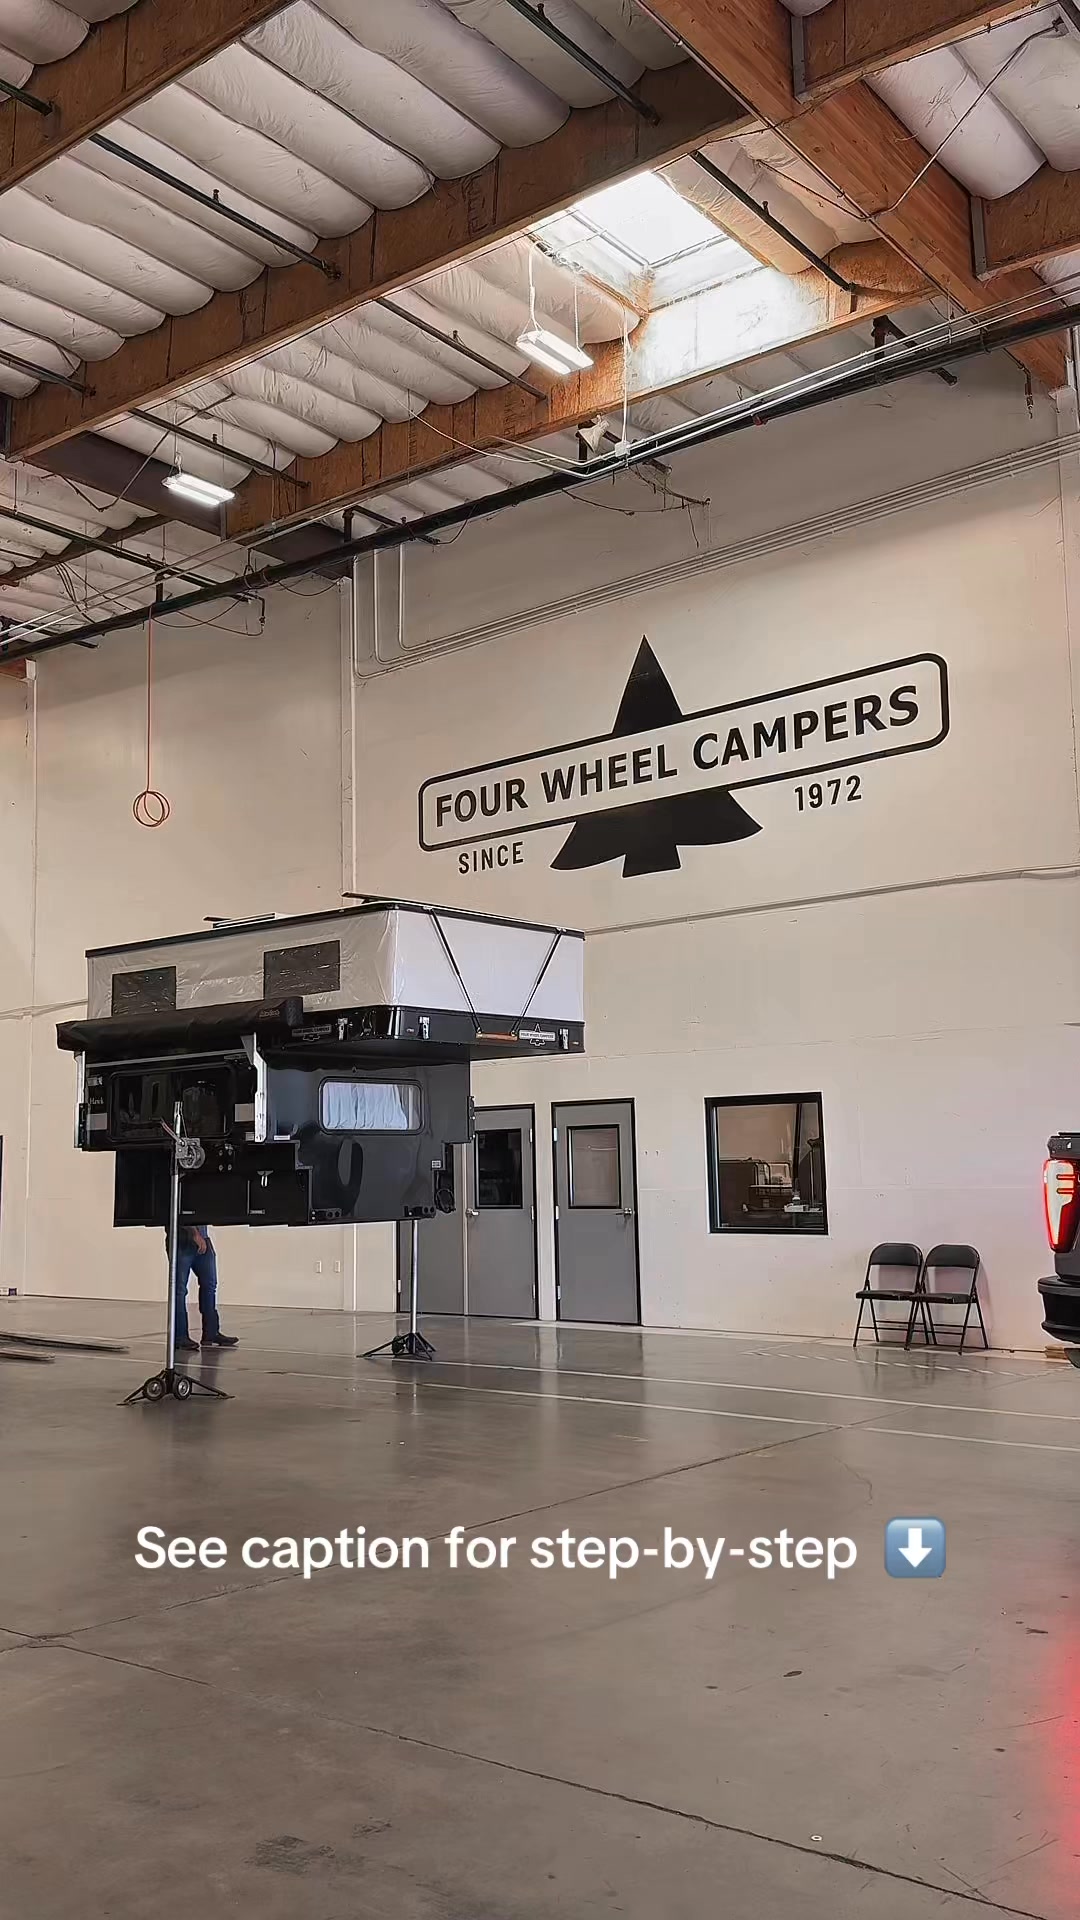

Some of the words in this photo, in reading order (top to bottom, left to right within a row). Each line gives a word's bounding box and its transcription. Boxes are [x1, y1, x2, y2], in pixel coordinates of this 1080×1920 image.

[436, 778, 529, 828] FOUR
[540, 743, 678, 804] WHEEL
[693, 685, 919, 770] CAMPERS
[458, 841, 524, 875] SINCE
[794, 775, 862, 811] 1972
